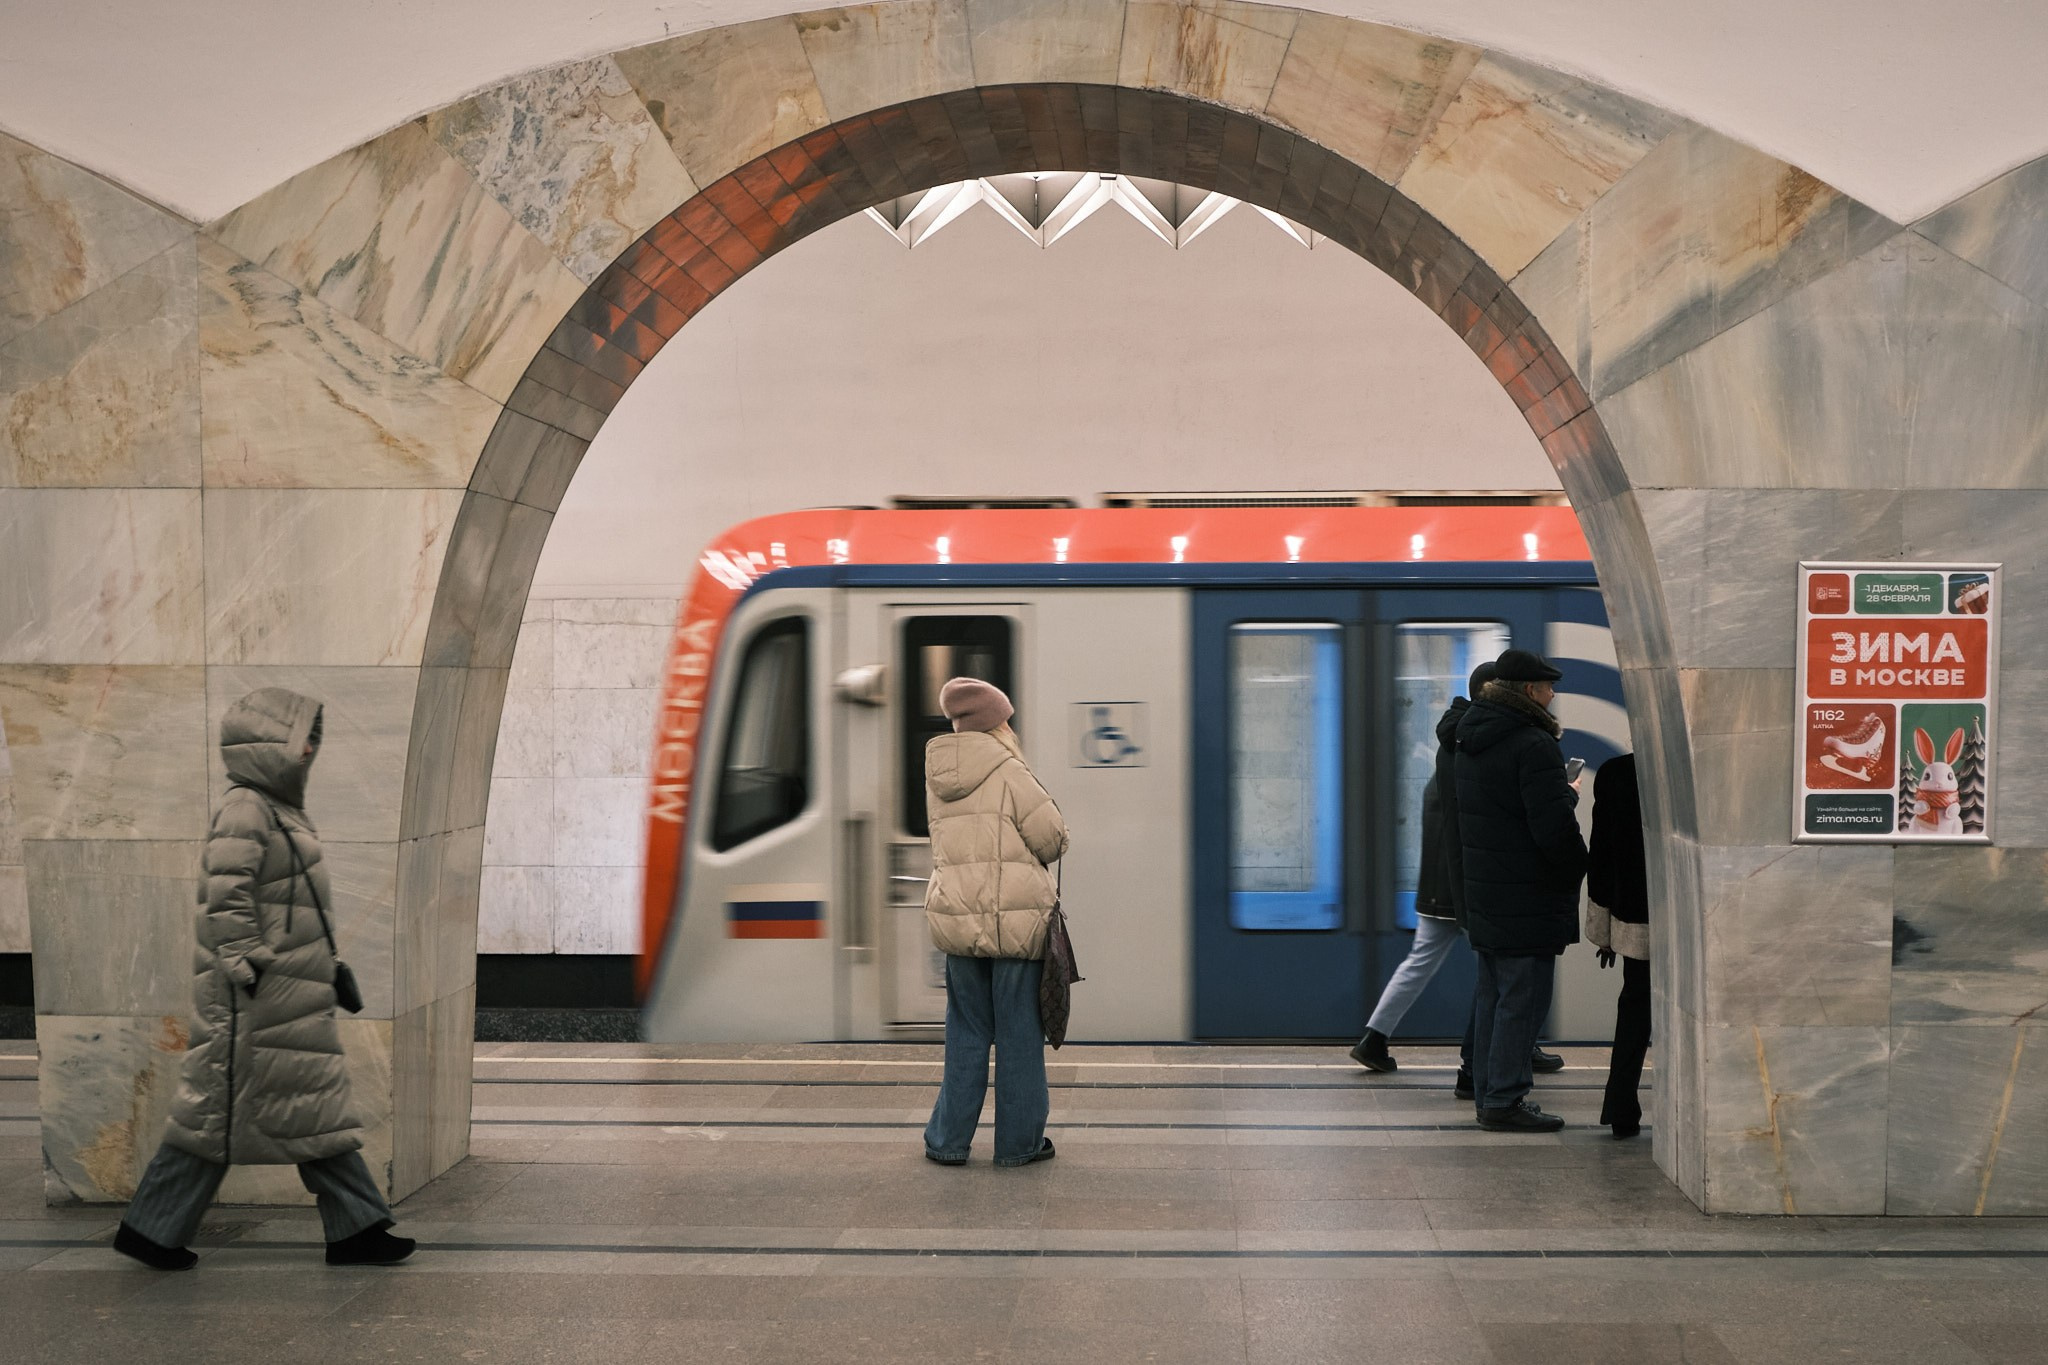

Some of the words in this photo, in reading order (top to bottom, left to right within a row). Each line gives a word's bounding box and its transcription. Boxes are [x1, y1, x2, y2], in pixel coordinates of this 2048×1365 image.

[1872, 584, 1919, 593] ДЕКАБРЯ
[1881, 594, 1931, 602] ФЕВРАЛЯ
[1830, 632, 1965, 663] ЗИМА
[1830, 668, 1847, 686] В
[1856, 668, 1965, 686] МОСКВЕ
[645, 619, 718, 823] МОСКВА
[1812, 710, 1845, 721] 1162
[1816, 814, 1883, 823] zima.mos.ru
